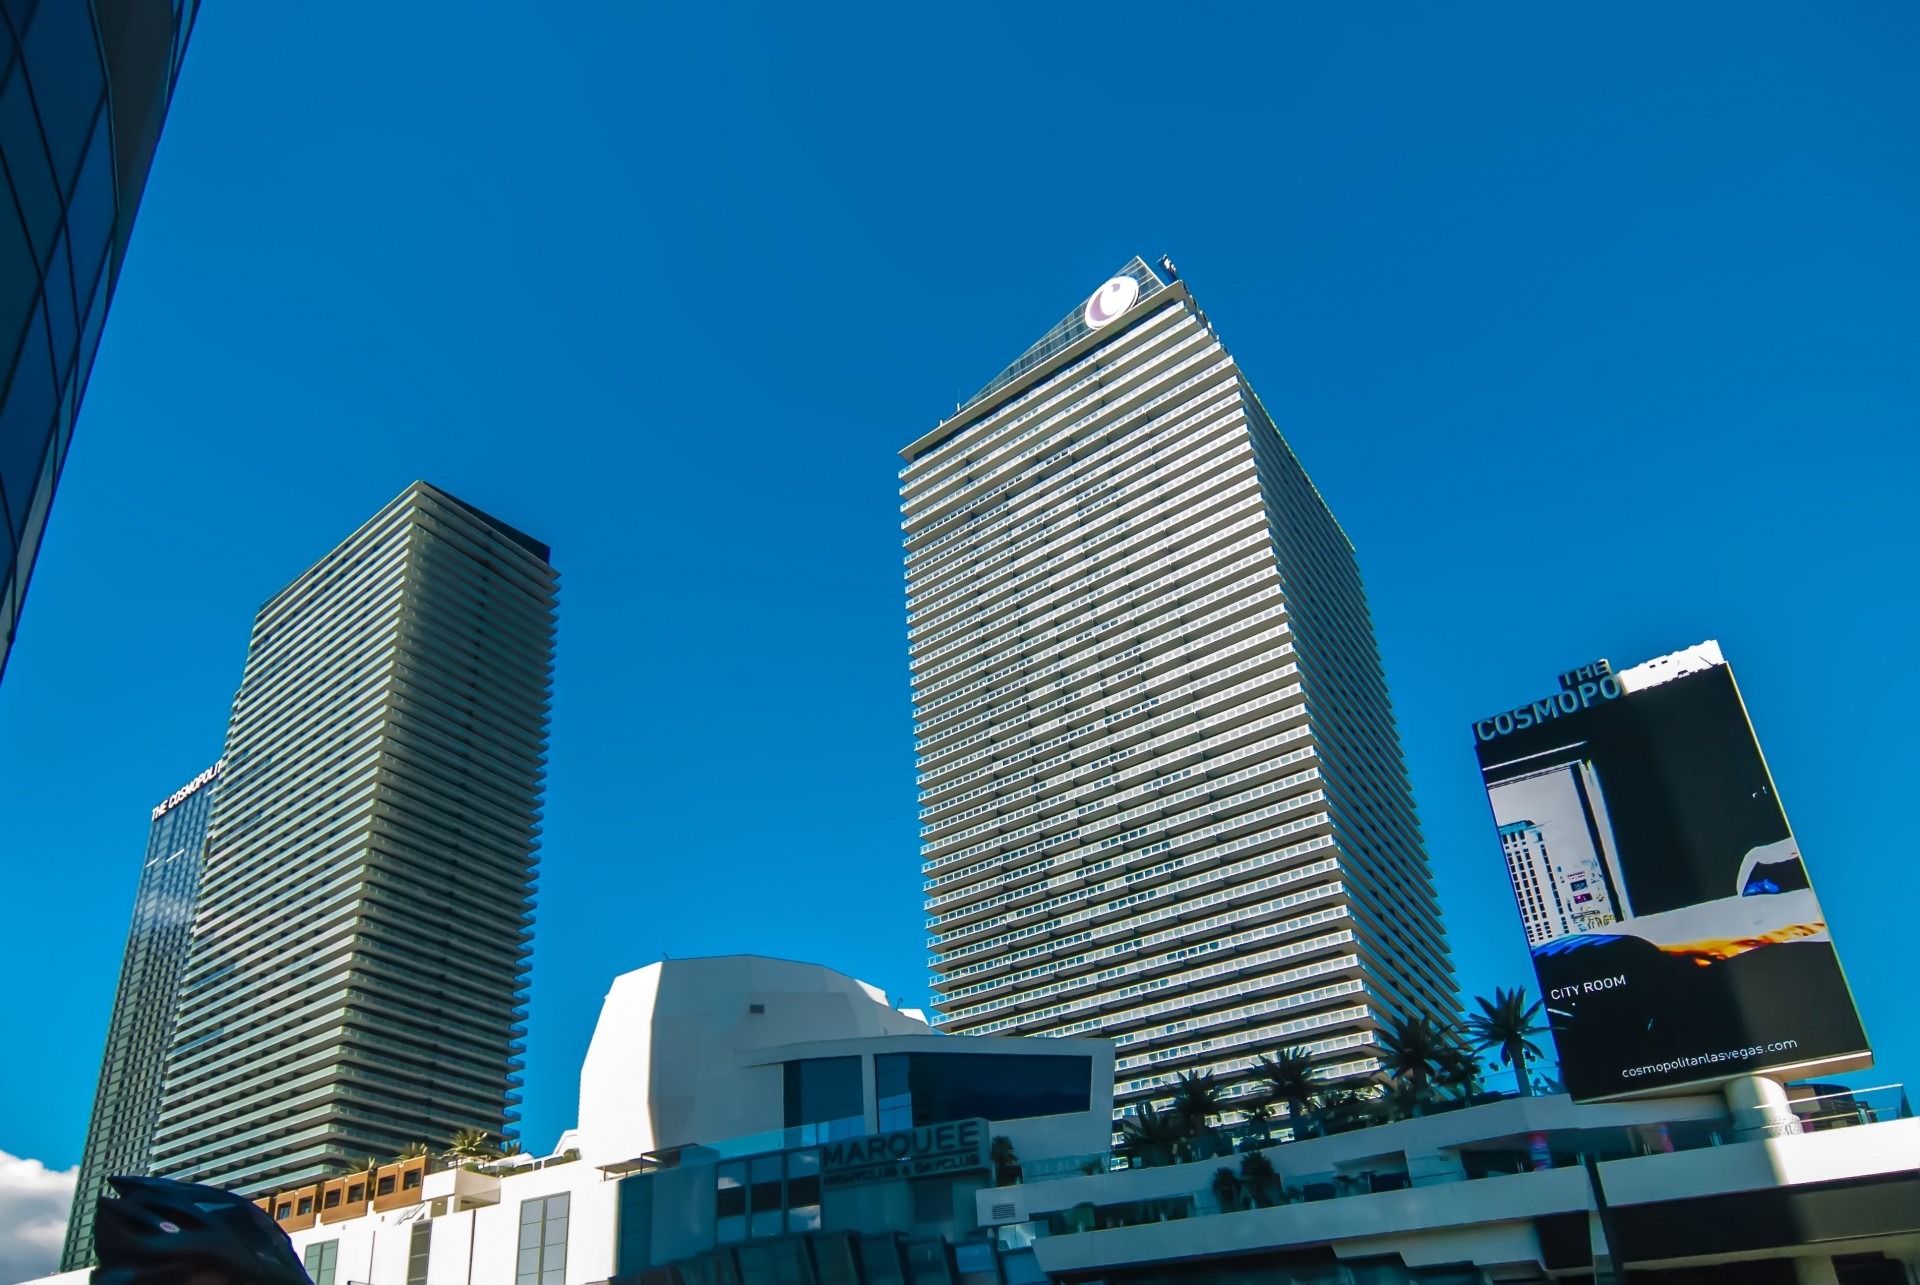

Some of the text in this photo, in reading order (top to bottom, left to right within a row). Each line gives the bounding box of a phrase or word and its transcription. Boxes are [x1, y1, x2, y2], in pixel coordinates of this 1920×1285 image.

[1564, 660, 1611, 686] THE
[152, 799, 168, 821] THE
[1550, 974, 1627, 1000] CITY ROOM
[1621, 1038, 1798, 1078] cosmopolitanlasvegas.com
[822, 1121, 979, 1168] MARQUEE
